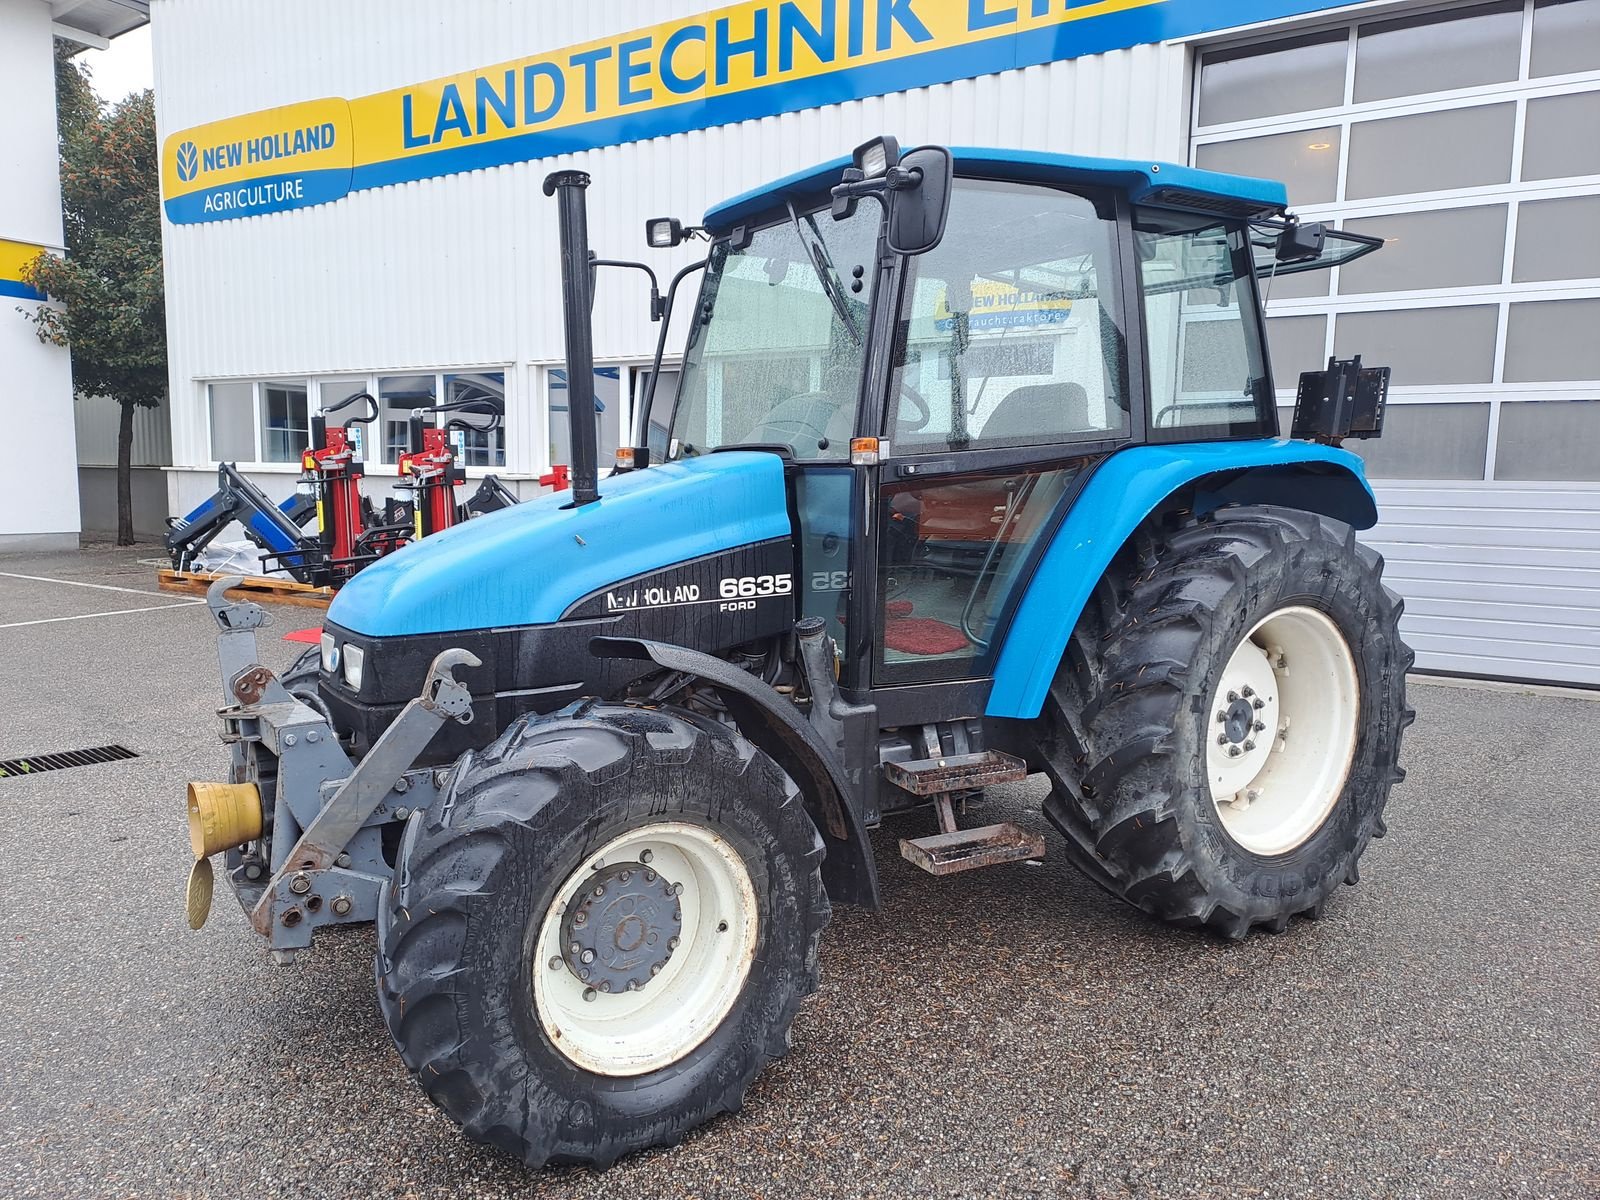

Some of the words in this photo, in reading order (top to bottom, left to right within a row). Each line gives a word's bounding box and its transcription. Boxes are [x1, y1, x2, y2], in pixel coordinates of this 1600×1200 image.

[403, 0, 933, 149] LANDTECHNIK
[203, 142, 243, 172] NEW
[247, 123, 335, 162] HOLLAND
[204, 179, 304, 214] AGRICULTURE
[719, 574, 793, 599] 6635
[719, 599, 757, 612] FORD
